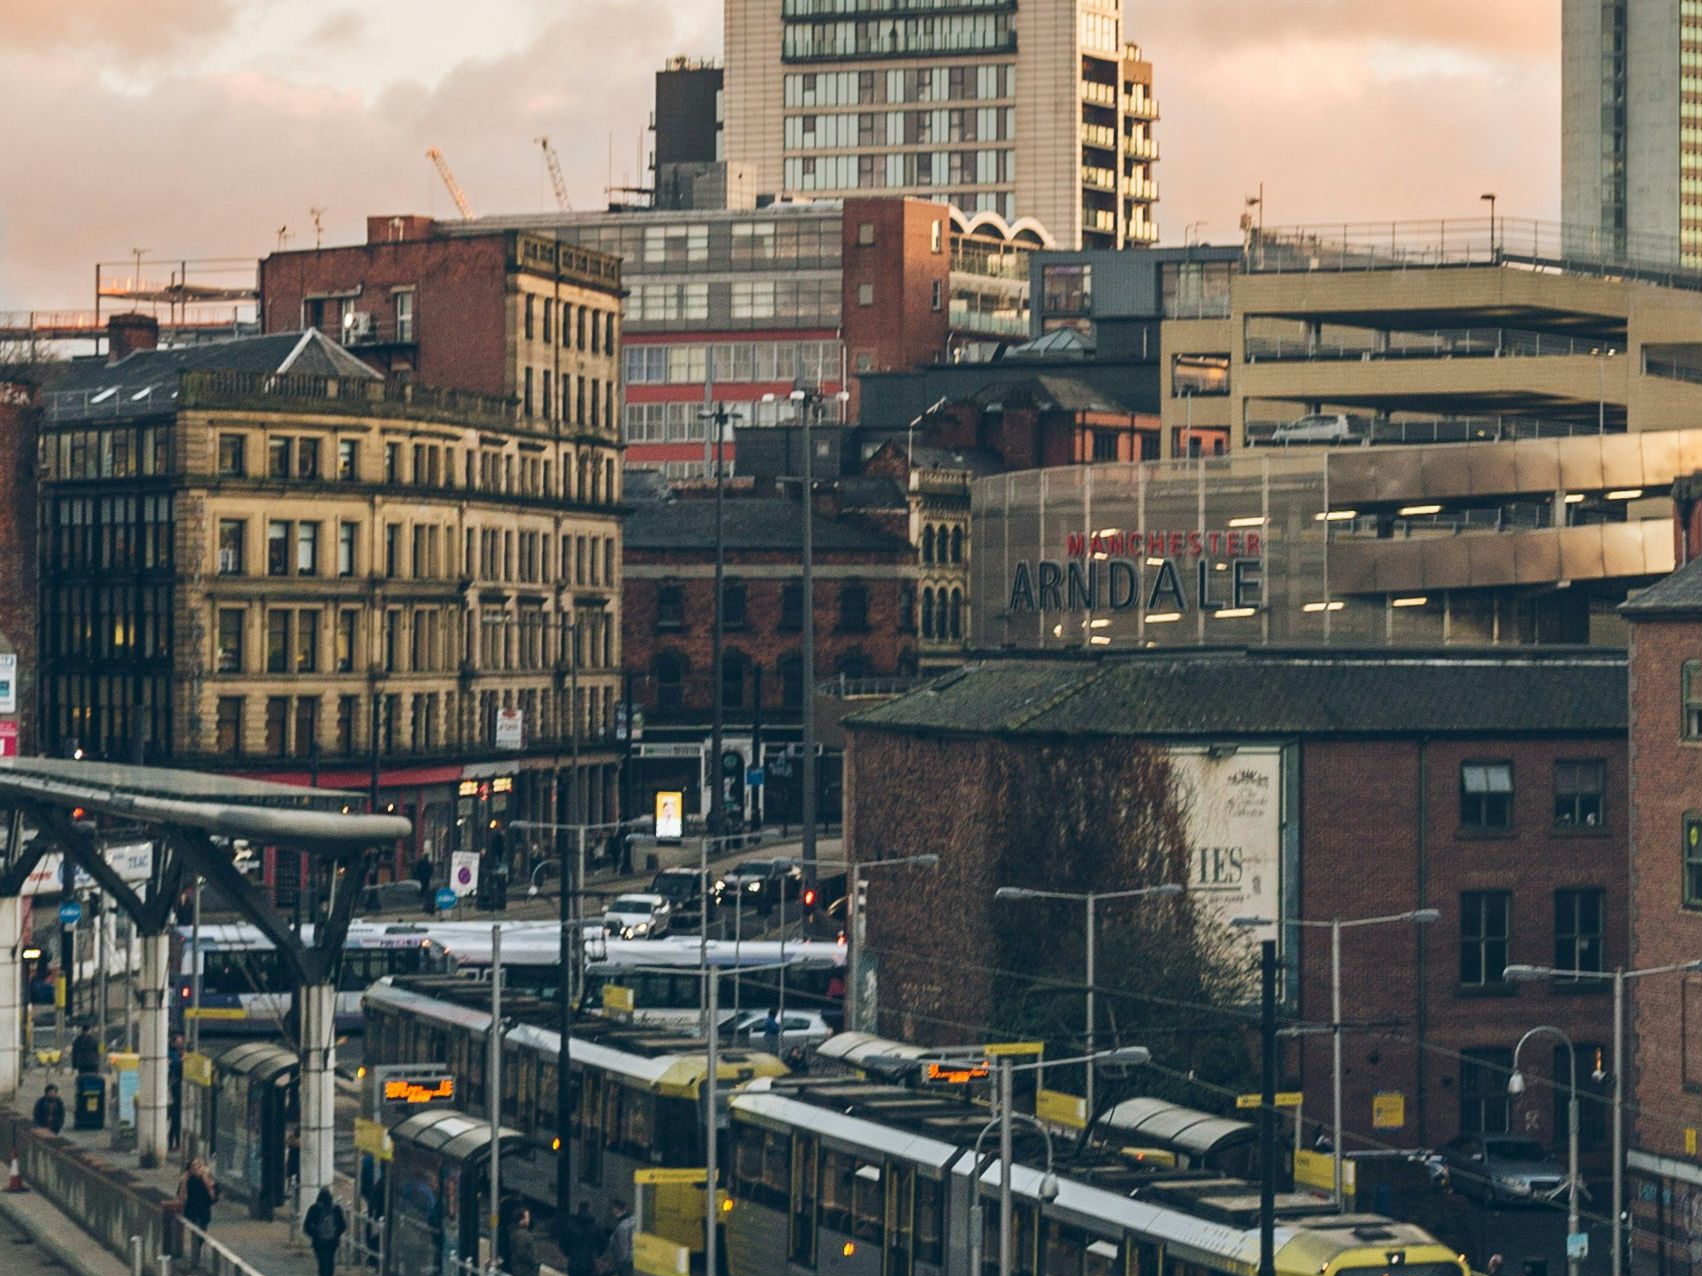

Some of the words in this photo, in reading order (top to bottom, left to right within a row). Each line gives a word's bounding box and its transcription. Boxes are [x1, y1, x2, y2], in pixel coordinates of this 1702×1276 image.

[1066, 530, 1261, 556] MANCHESTER
[1009, 558, 1263, 612] ARNDALE
[1200, 846, 1244, 884] IES
